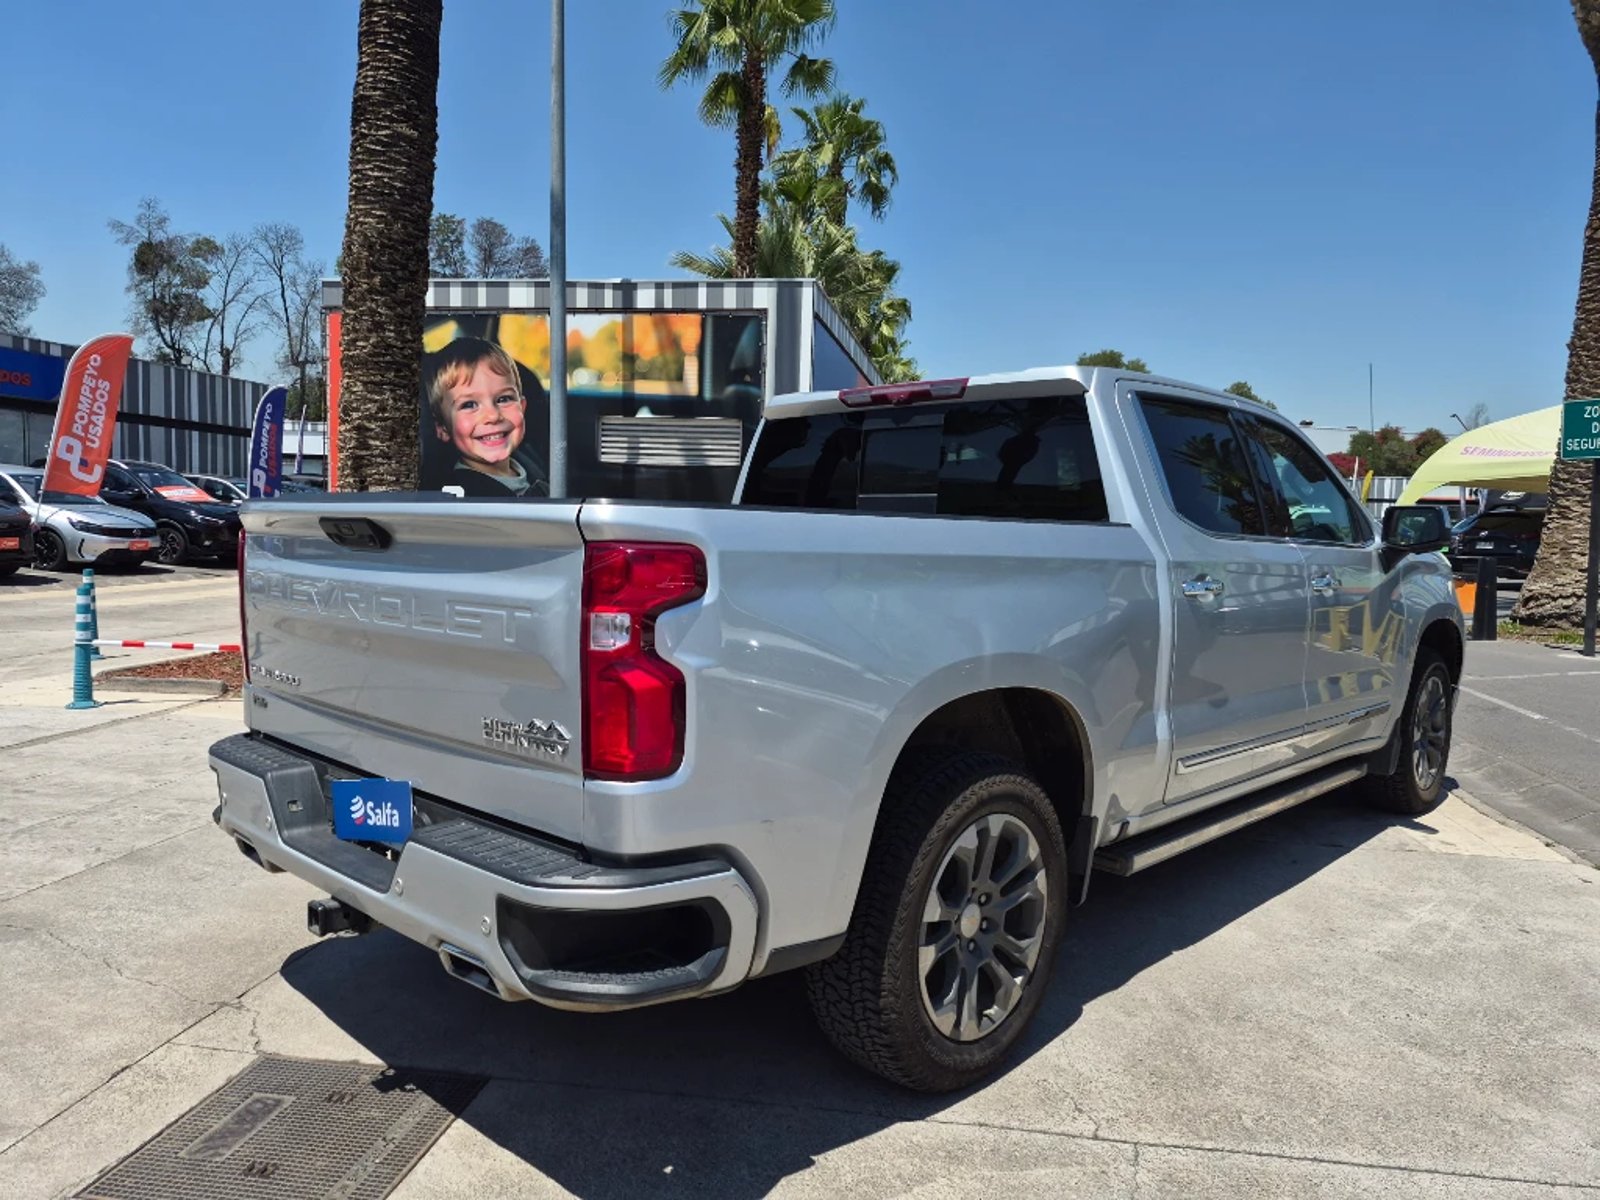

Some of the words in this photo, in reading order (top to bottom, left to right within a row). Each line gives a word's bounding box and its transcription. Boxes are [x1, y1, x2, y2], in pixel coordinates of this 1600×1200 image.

[72, 354, 101, 437] POMPEYO
[85, 379, 110, 448] USADOS
[259, 402, 273, 469] POMPEYO
[247, 568, 533, 643] CHEVROLET
[366, 801, 400, 828] Salfa
